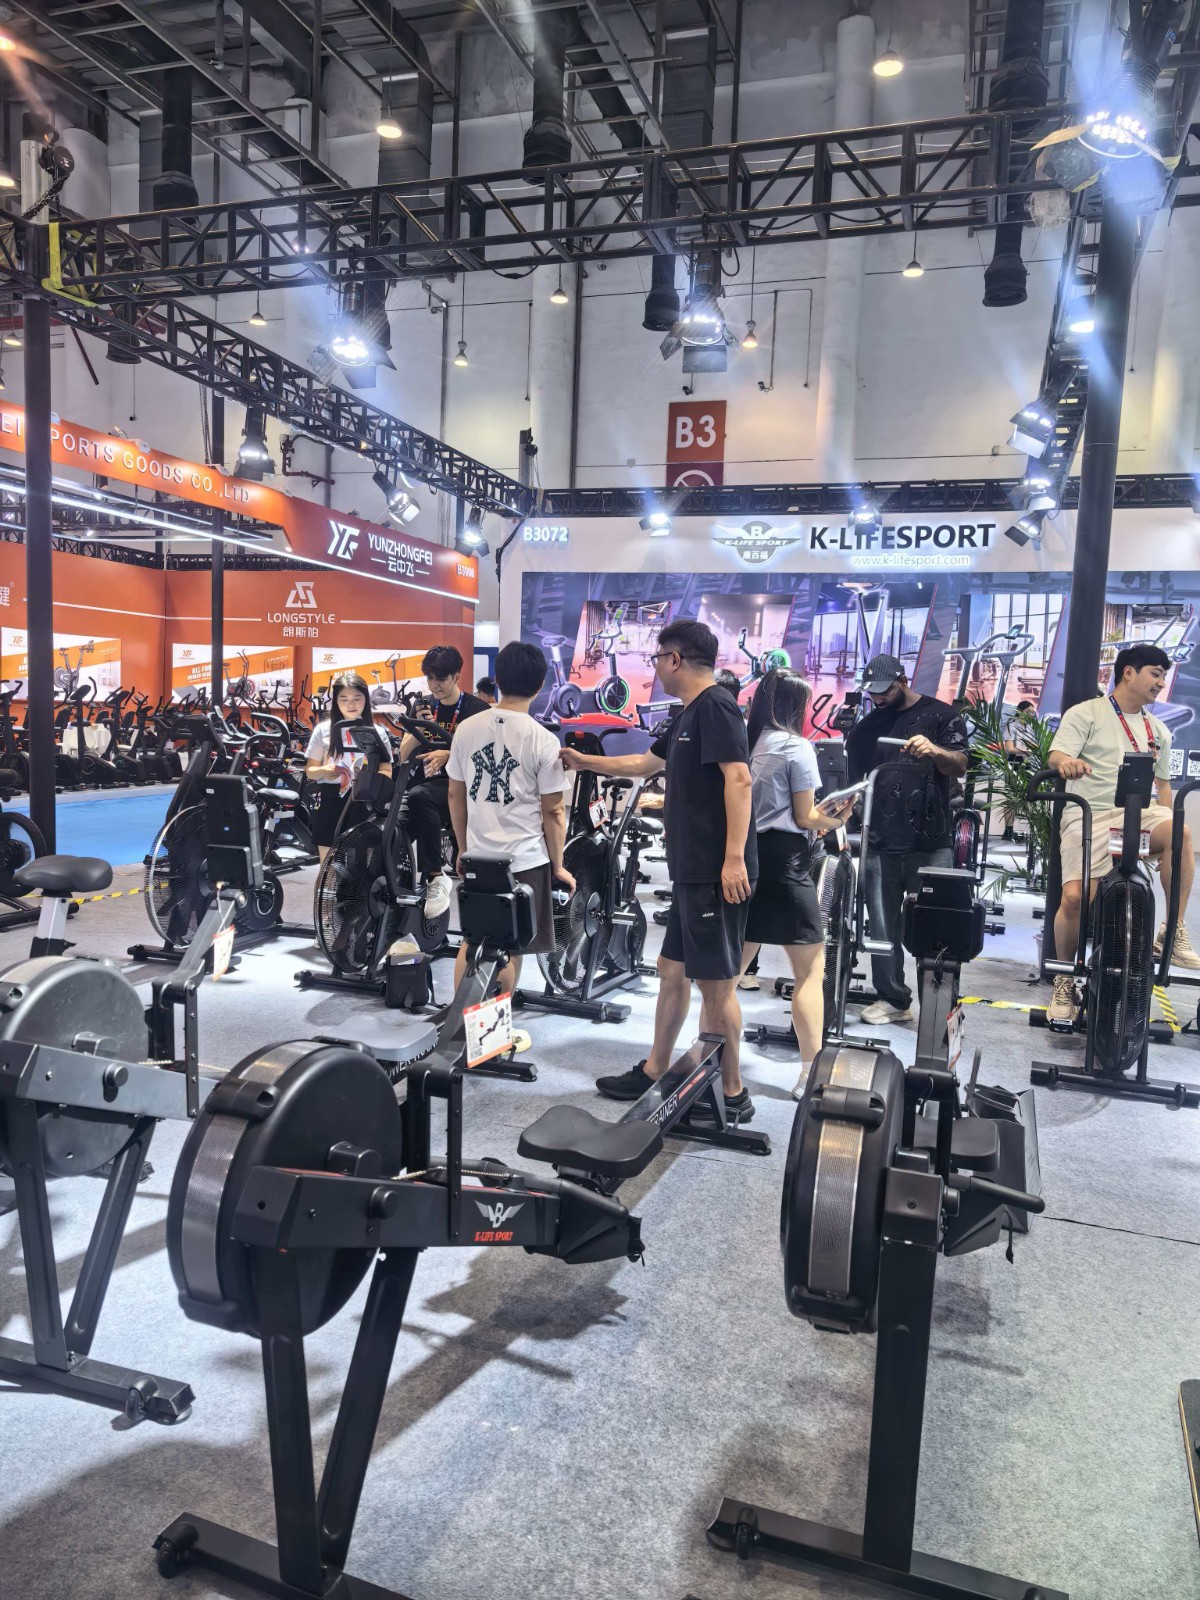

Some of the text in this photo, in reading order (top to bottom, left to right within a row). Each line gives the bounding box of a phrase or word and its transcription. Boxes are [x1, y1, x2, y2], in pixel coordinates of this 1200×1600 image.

[675, 415, 716, 448] B3
[51, 428, 114, 463] PORTS
[123, 451, 183, 483] GOODS
[523, 526, 569, 542] B3072
[810, 524, 996, 550] K-LIFESPORT
[368, 532, 433, 566] YUNZHONGFEI
[388, 556, 414, 577] 云中飞
[853, 555, 969, 568] www.k-lifesport.com
[267, 612, 336, 624] LONGSTYLE
[650, 1094, 678, 1124] RAINER
[474, 1231, 513, 1242] K-LIFE SPORT
